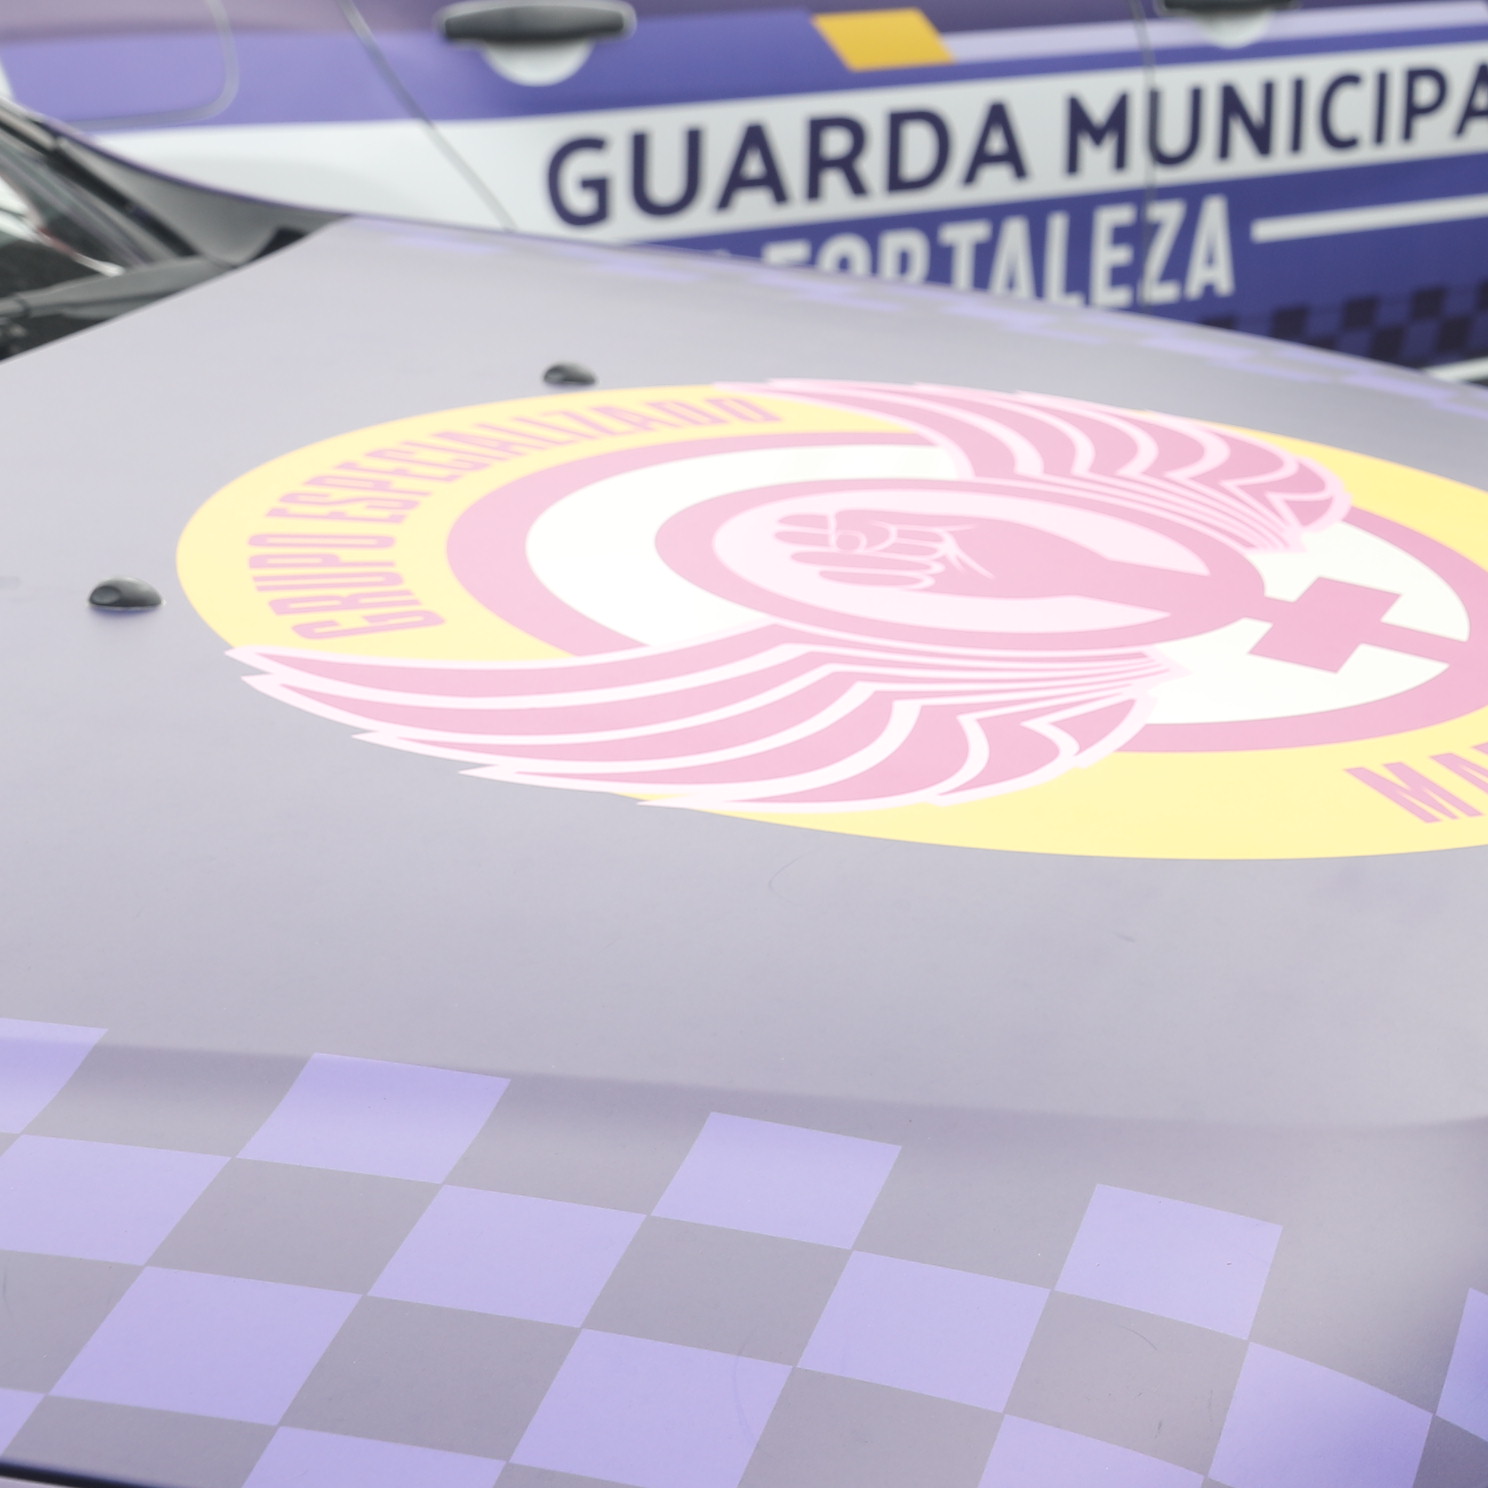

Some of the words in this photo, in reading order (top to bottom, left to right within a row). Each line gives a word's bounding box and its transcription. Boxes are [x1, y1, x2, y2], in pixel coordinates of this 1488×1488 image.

[547, 100, 1030, 227] GUARDA
[762, 194, 1235, 309] TALEZA
[264, 397, 784, 526] ESPECIALIZADO
[247, 532, 446, 642] GRUPO
